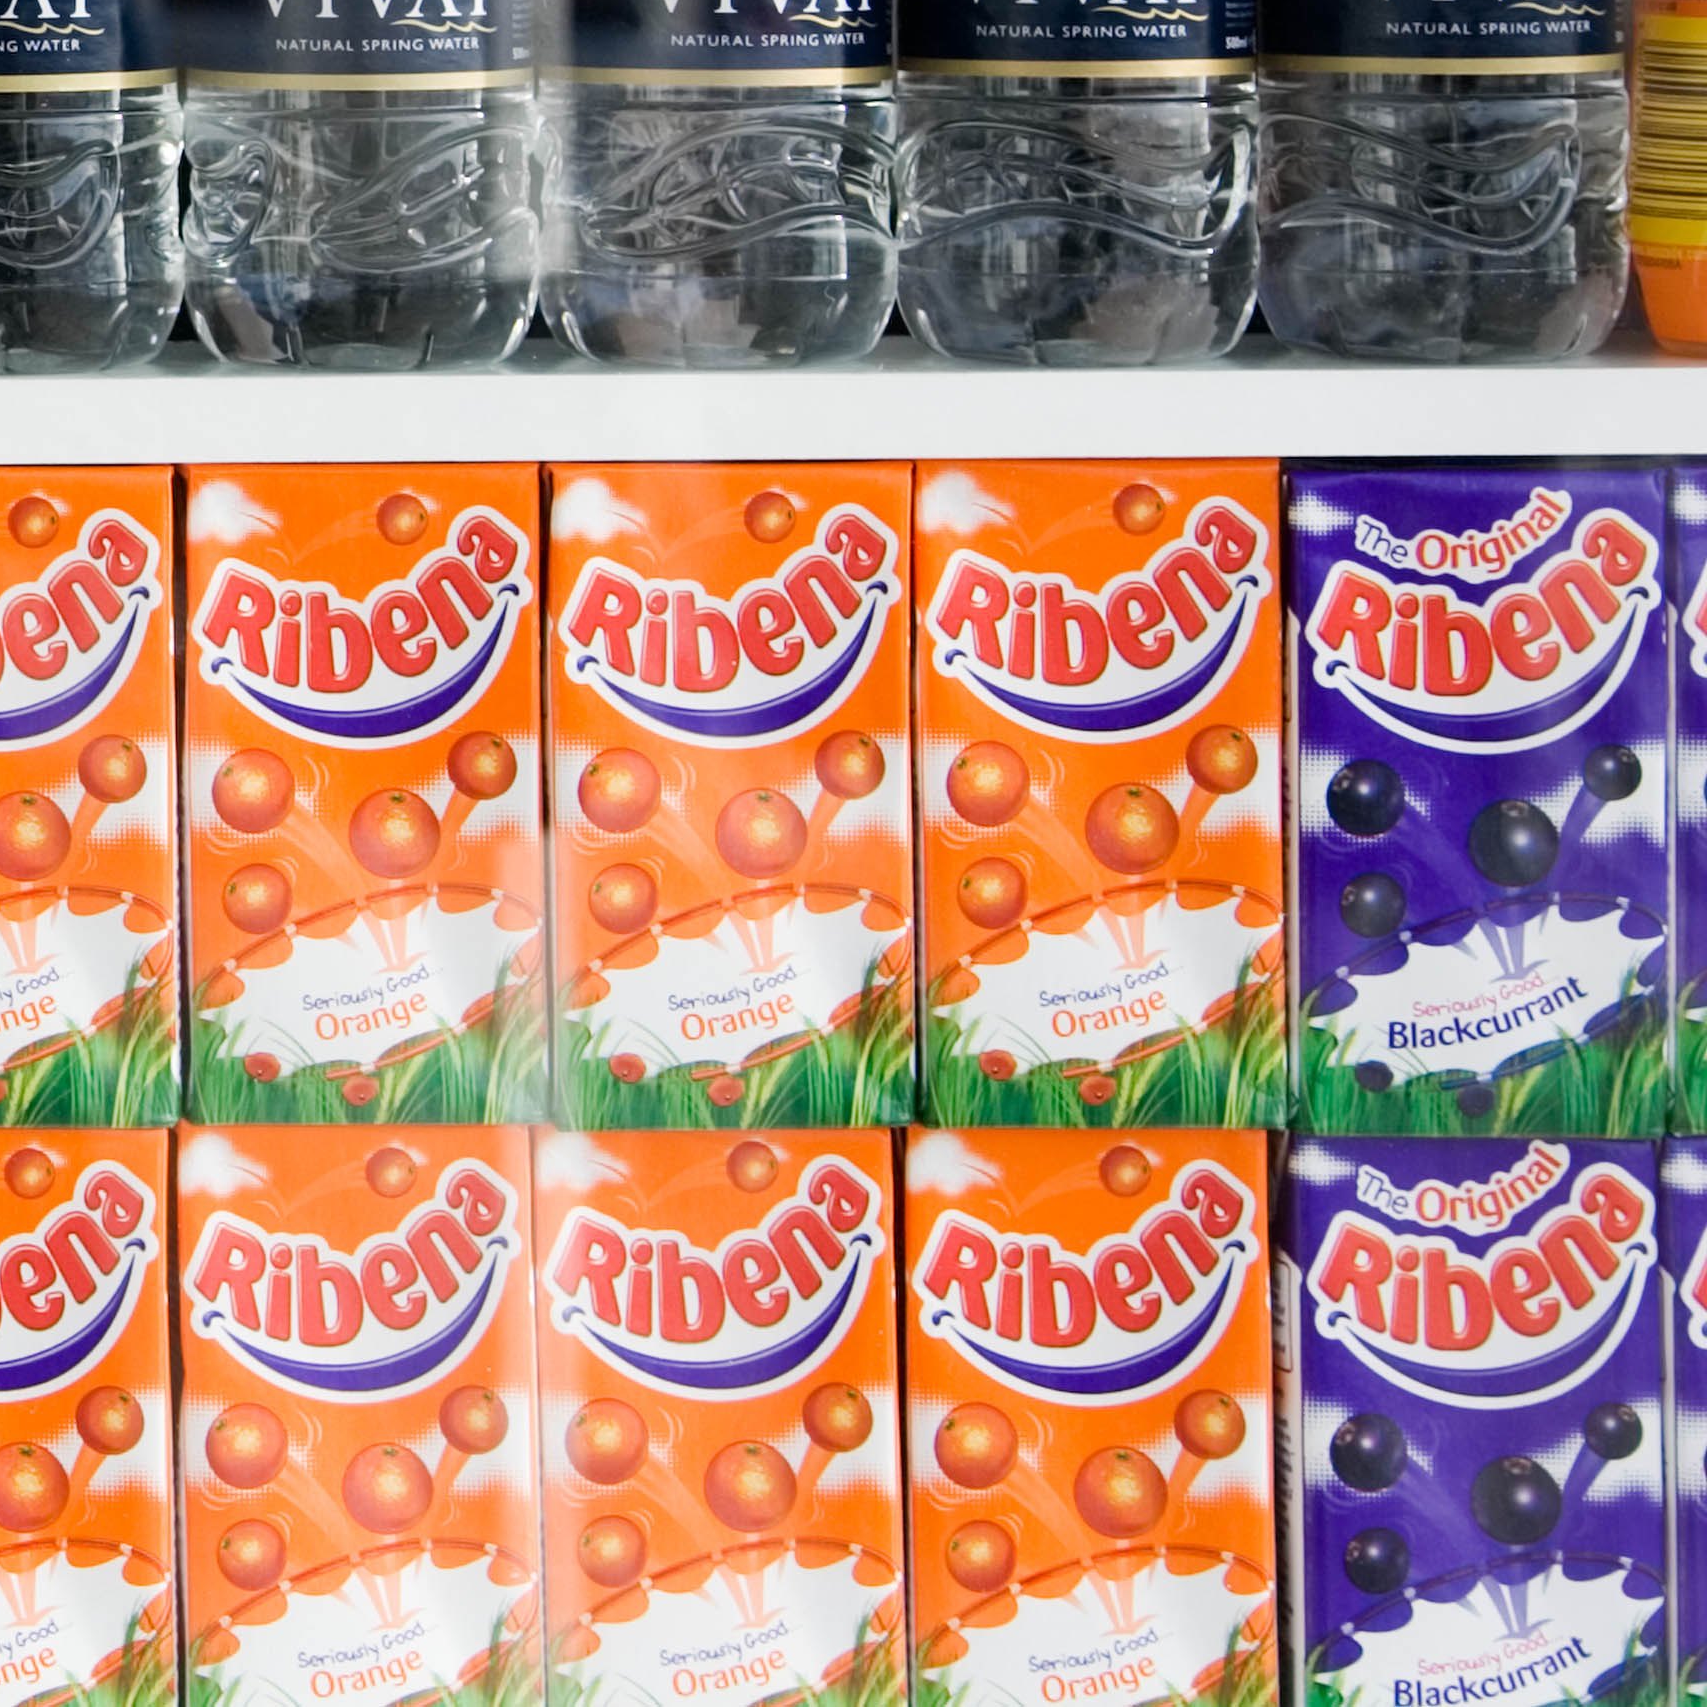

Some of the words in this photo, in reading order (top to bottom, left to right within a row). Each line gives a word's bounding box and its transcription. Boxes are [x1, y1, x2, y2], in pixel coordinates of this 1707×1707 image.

[24, 39, 80, 51] WATER
[977, 25, 1053, 37] NATURAL
[1063, 26, 1126, 38] SPRING
[1133, 25, 1186, 37] WATER
[1358, 521, 1407, 565] The
[1416, 493, 1563, 573] Original
[1317, 517, 1647, 696] Ribena
[1389, 977, 1587, 1048] Blackcurrant
[1412, 994, 1497, 1017] Seriously
